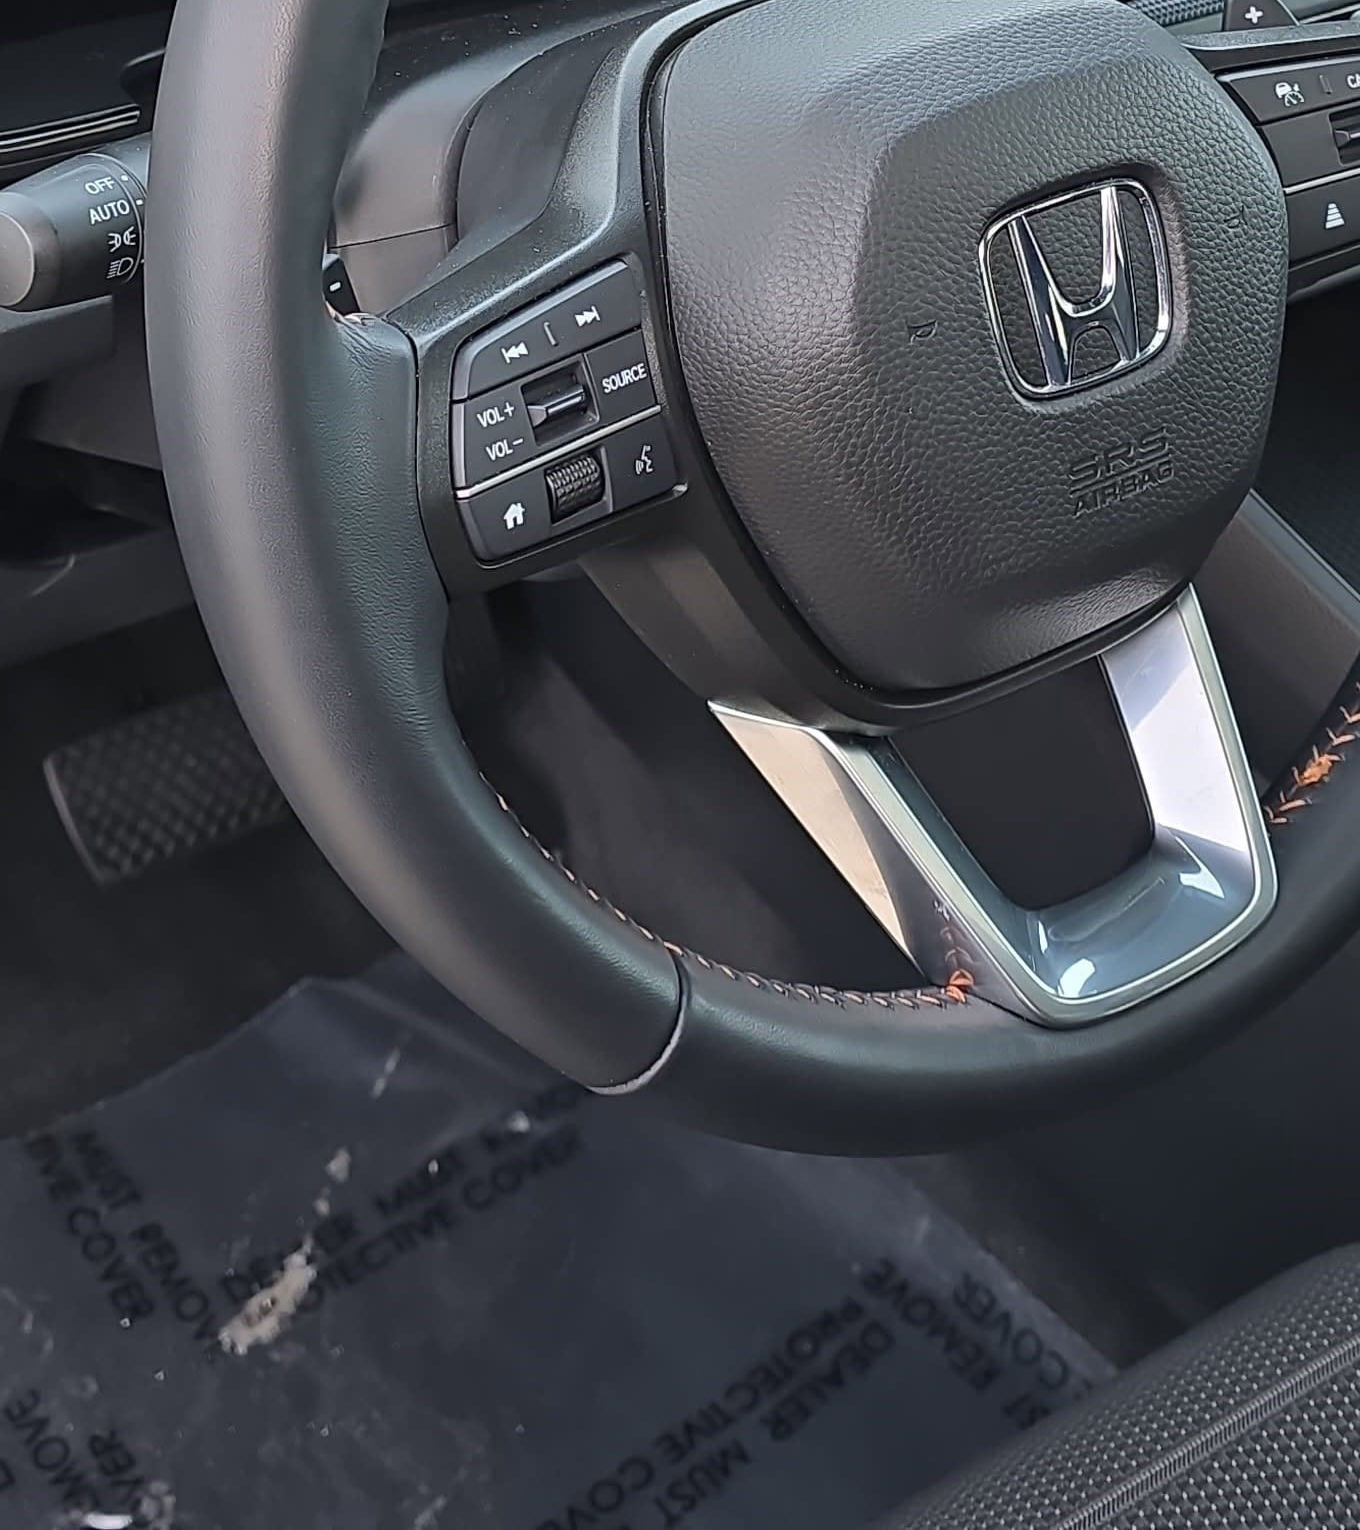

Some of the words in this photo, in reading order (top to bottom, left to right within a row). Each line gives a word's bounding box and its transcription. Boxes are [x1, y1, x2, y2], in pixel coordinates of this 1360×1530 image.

[84, 176, 116, 195] OFF
[89, 199, 131, 225] AUTO
[602, 363, 648, 394] SOURCE
[66, 1206, 155, 1320] COVER
[651, 1294, 866, 1465] PROTECTIVE
[762, 1320, 895, 1443] DEALER
[860, 1257, 1001, 1393] REMOVE
[952, 1272, 1069, 1392] COVER
[655, 1438, 752, 1529] MUST
